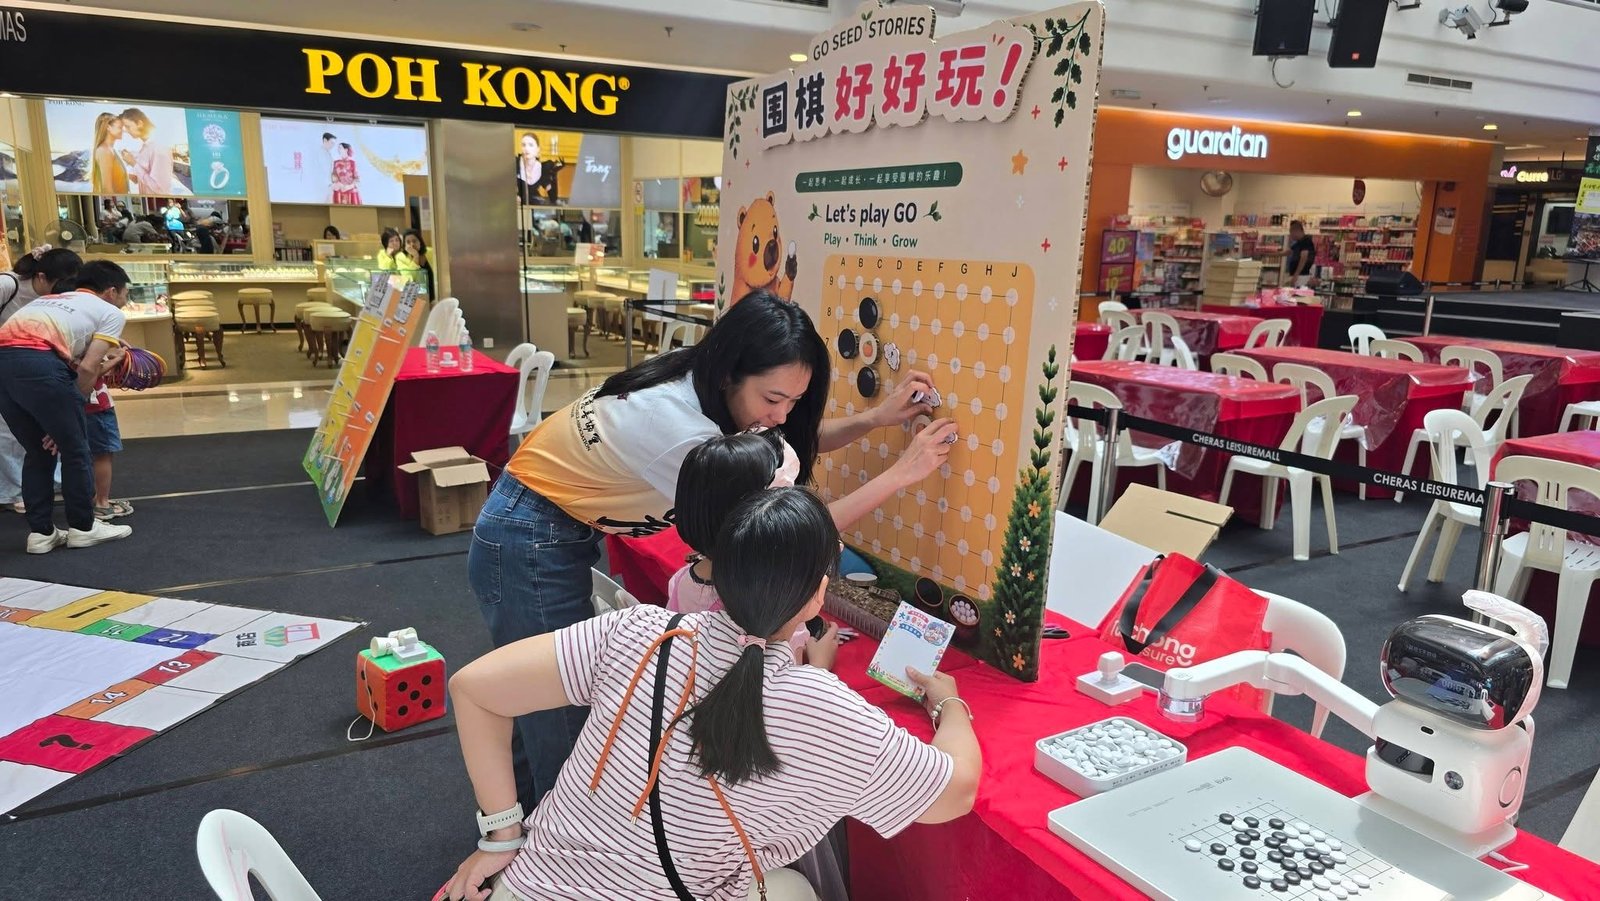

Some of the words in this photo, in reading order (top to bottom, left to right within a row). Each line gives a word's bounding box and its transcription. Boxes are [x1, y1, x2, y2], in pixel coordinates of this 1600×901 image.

[813, 40, 829, 60] GO
[832, 25, 863, 51] SEED
[868, 16, 926, 38] STORIES
[302, 48, 442, 103] POH
[1167, 125, 1268, 160] guardian
[826, 204, 856, 223] Let's
[860, 203, 889, 227] play
[893, 202, 917, 223] GO
[824, 232, 841, 247] Play
[854, 233, 878, 247] Think
[892, 234, 918, 248] Grow
[841, 257, 846, 267] A
[859, 258, 864, 268] B
[877, 259, 883, 270] C
[897, 260, 903, 271] D
[917, 261, 923, 272] E
[938, 262, 944, 273] F
[961, 263, 968, 275] G
[985, 265, 993, 277] H
[1012, 266, 1018, 278] J
[829, 276, 834, 286] 9
[827, 307, 832, 317] 8
[1192, 433, 1224, 449] CHERAS
[1226, 440, 1280, 462] LEISUREMALL
[1373, 472, 1417, 491] CHERAS
[158, 660, 192, 674] 13
[90, 690, 127, 705] 14
